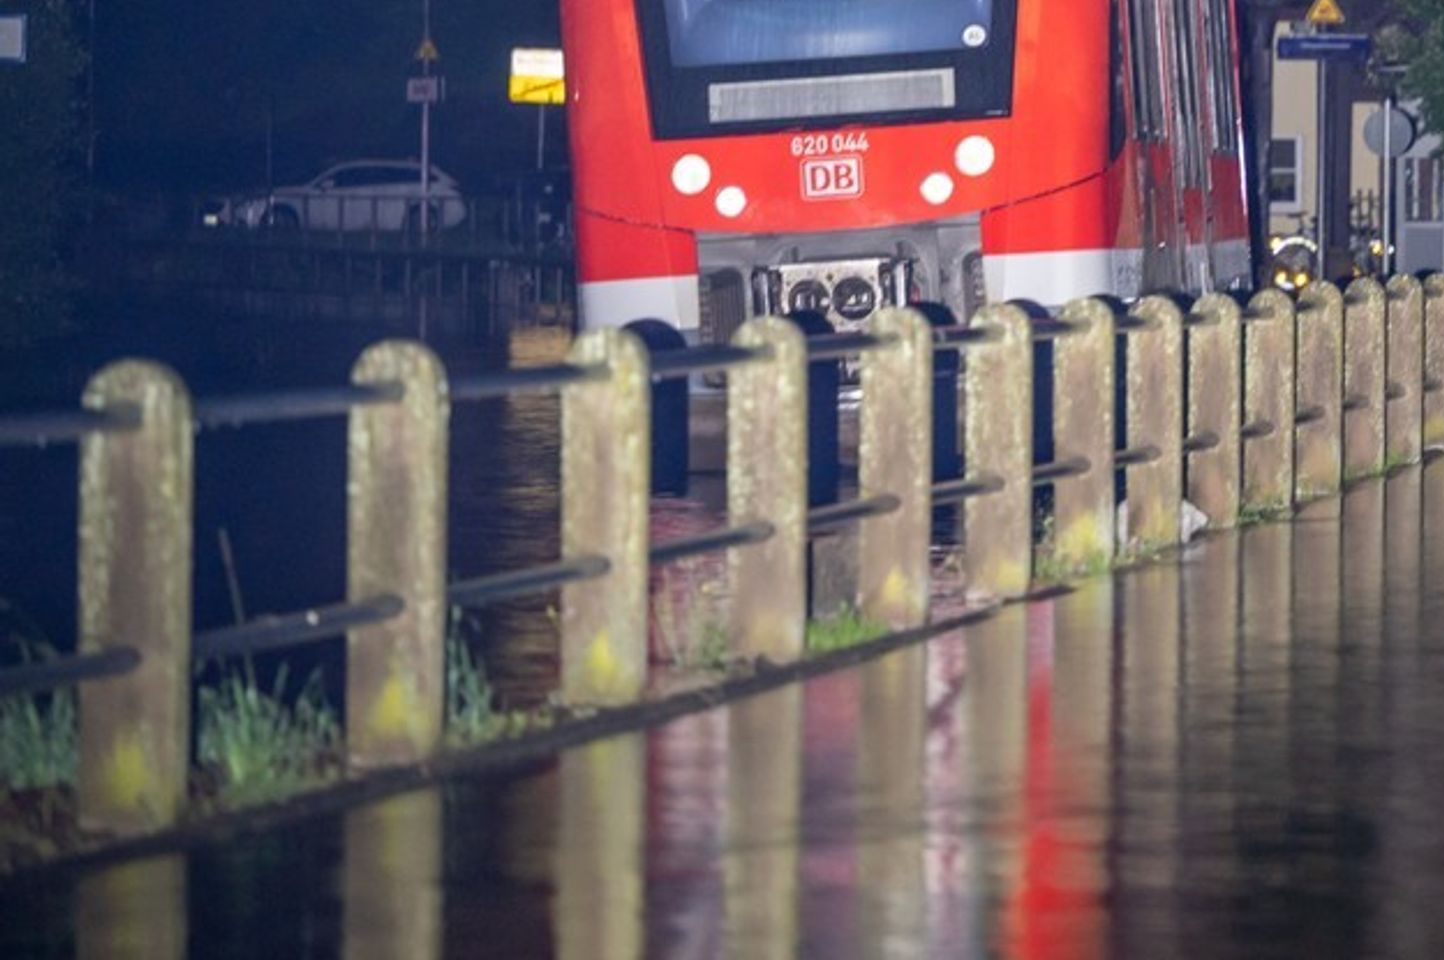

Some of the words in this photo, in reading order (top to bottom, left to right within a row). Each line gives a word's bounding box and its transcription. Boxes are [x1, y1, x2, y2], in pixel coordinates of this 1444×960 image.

[791, 134, 829, 157] 620
[831, 131, 870, 154] 044
[809, 164, 854, 192] DB
